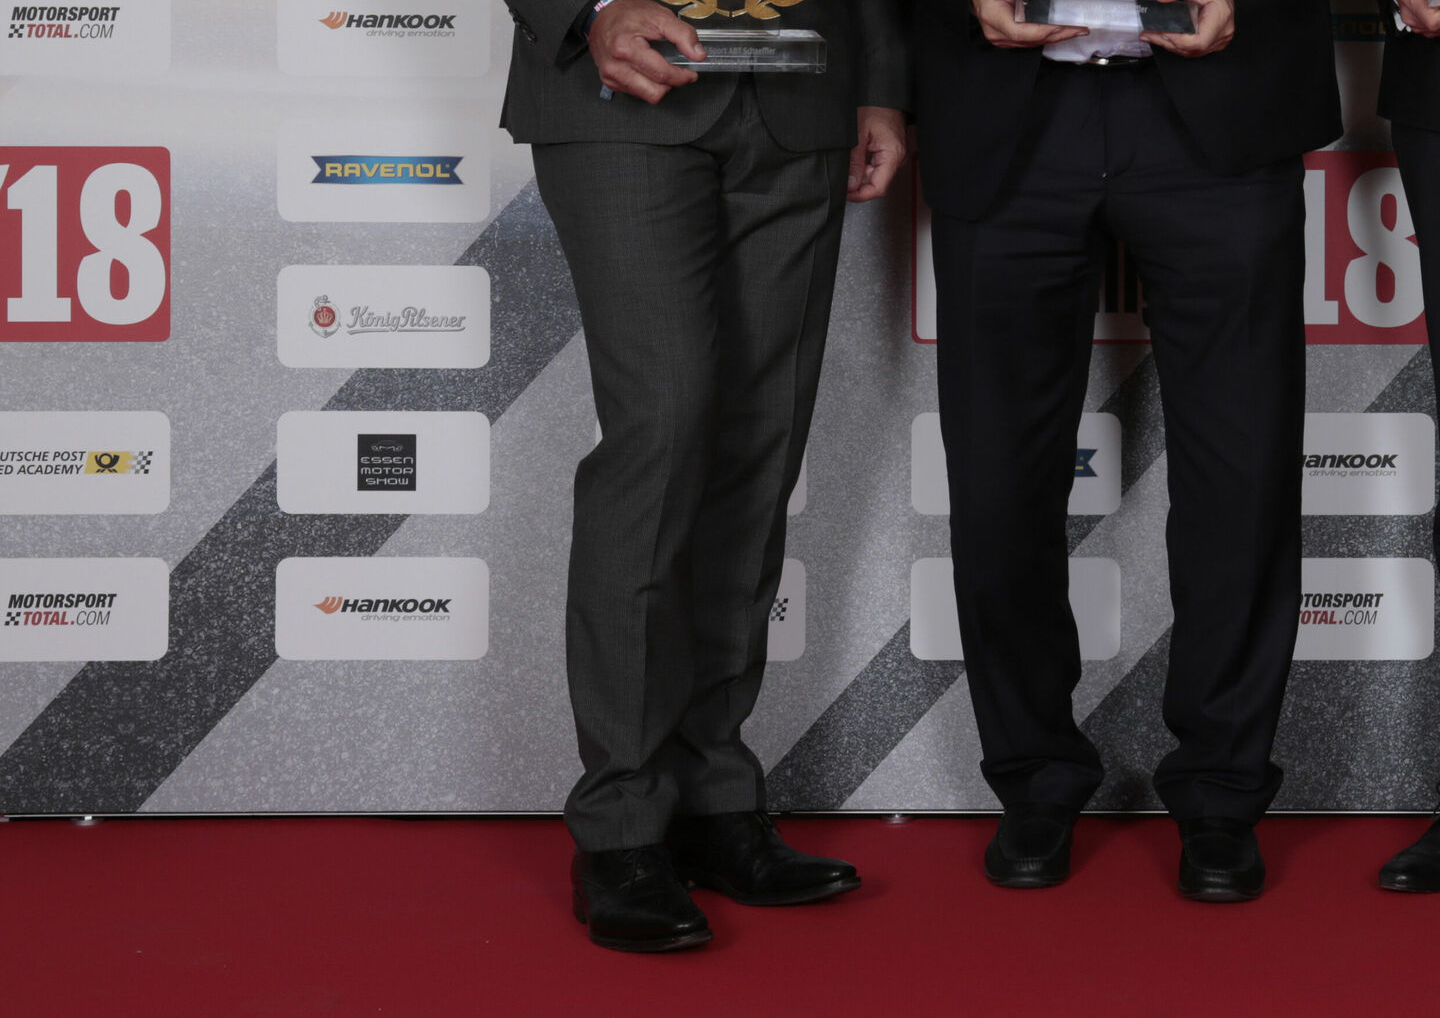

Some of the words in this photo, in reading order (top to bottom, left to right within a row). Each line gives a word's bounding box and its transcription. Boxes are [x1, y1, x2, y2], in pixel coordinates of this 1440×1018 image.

[11, 6, 120, 22] MOTORSPORT
[26, 23, 114, 39] TOTAL.COM
[366, 29, 405, 38] driving
[325, 163, 451, 178] RAVENOL
[1304, 168, 1425, 328] 18
[0, 451, 49, 462] UTSCHE
[53, 451, 86, 462] POST
[19, 464, 84, 475] ACADEMY
[1309, 469, 1347, 477] driving
[366, 477, 409, 486] SHOW
[9, 593, 117, 609] MOTORSPORT
[1303, 593, 1383, 608] TORSPORT
[23, 610, 111, 626] TOTAL.COM
[361, 614, 399, 622] driving
